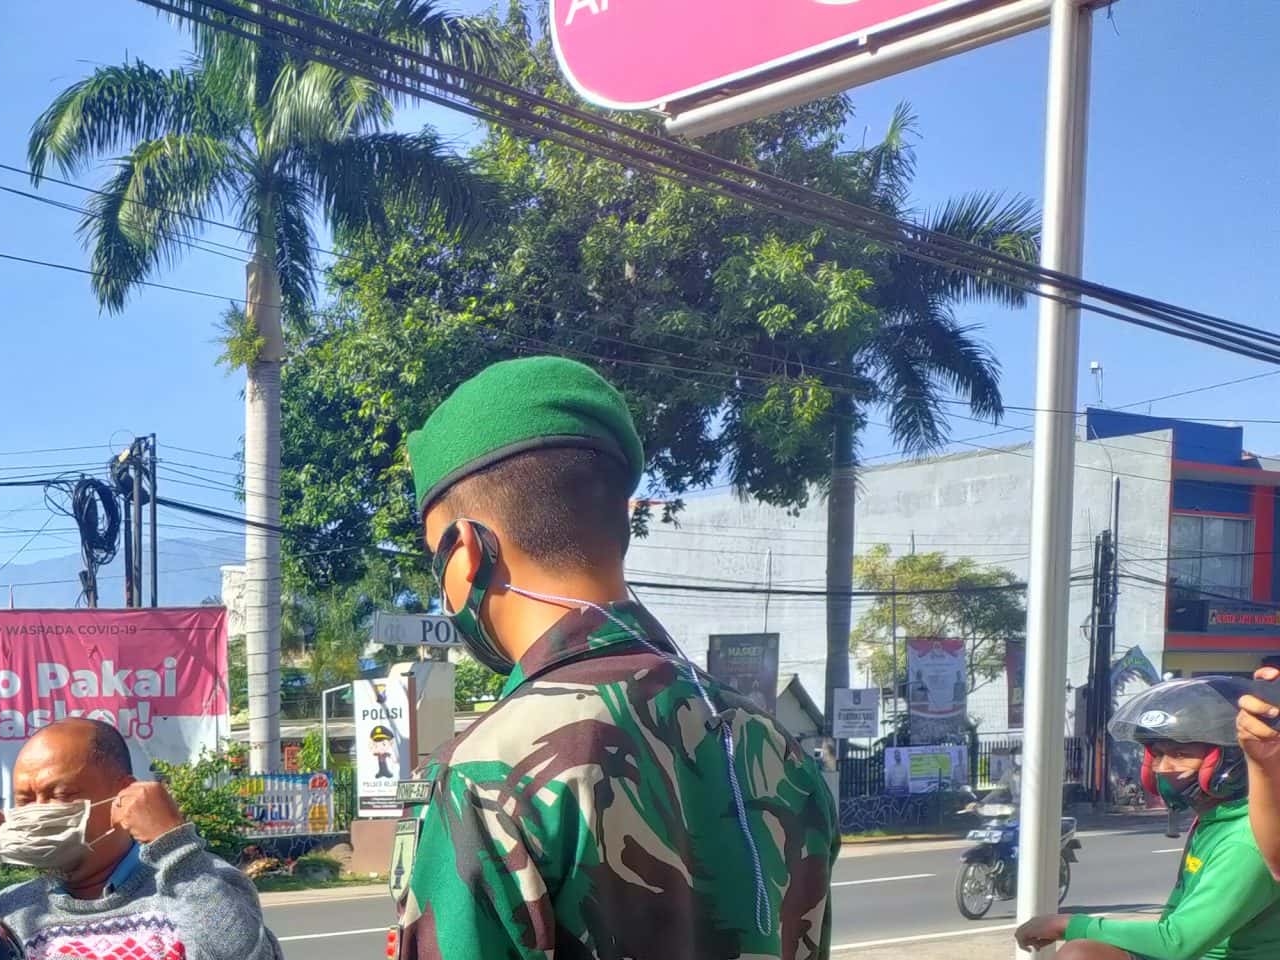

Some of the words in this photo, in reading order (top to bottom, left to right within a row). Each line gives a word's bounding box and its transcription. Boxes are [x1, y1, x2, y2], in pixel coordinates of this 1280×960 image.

[6, 625, 74, 636] WASPADA
[78, 624, 137, 636] COVID-19
[37, 656, 178, 699] Pakai
[362, 708, 402, 720] POLISI
